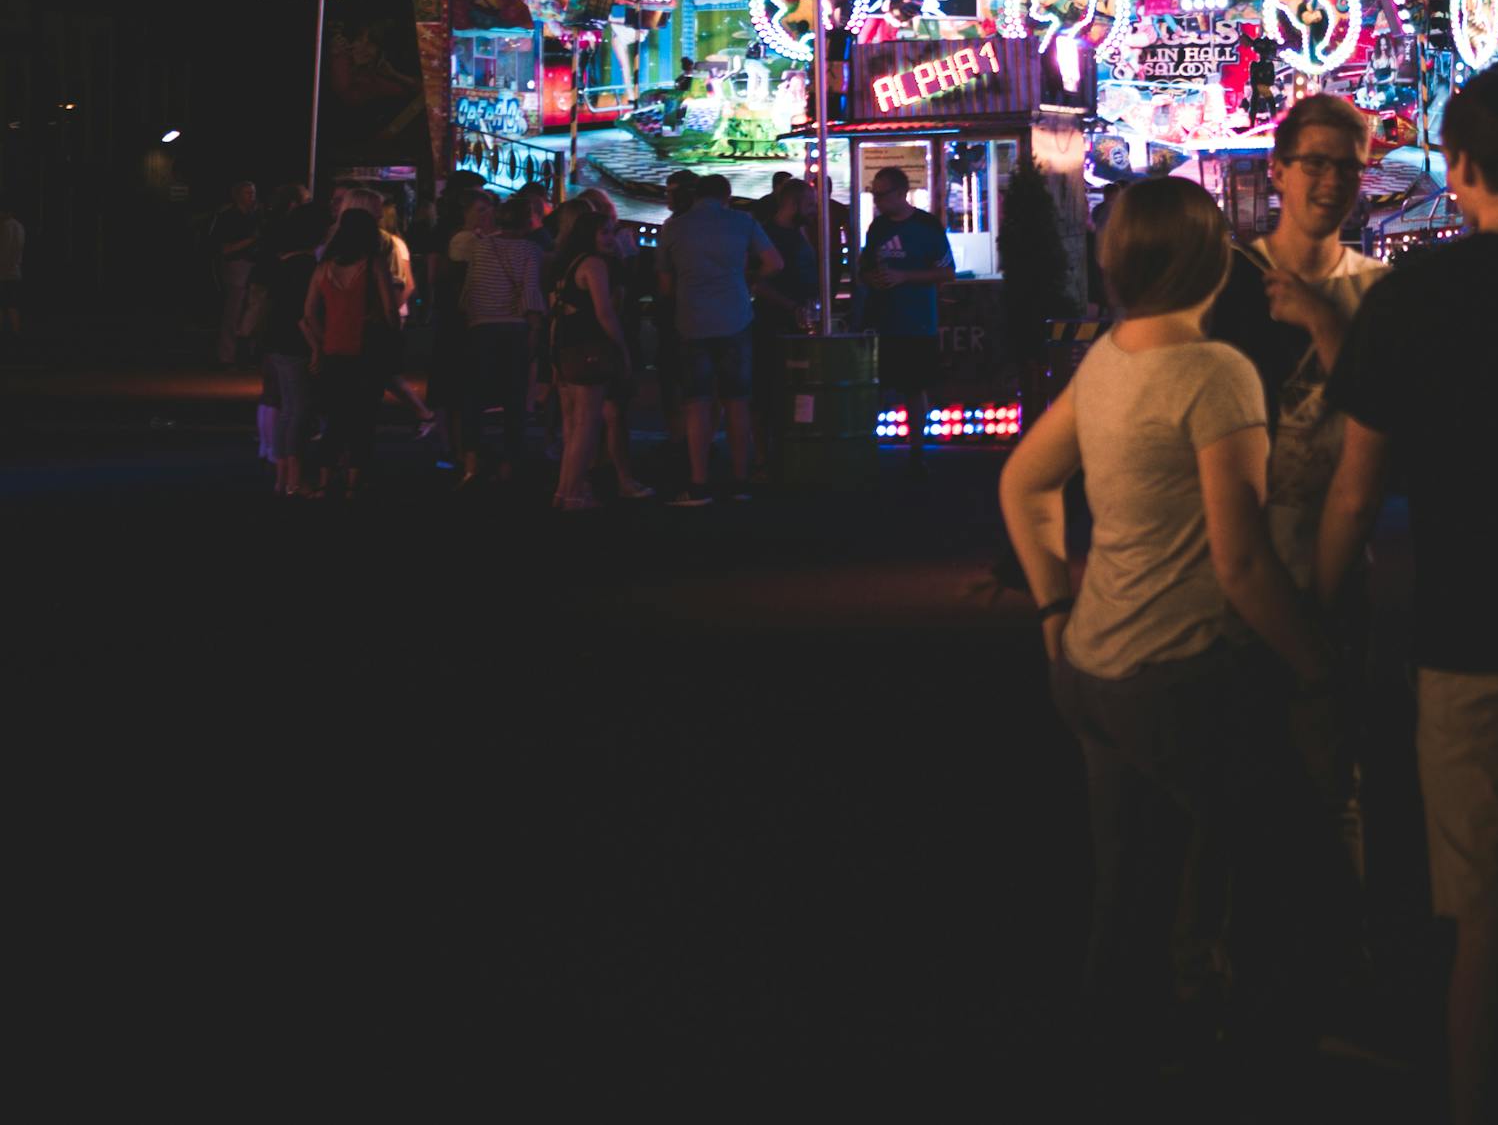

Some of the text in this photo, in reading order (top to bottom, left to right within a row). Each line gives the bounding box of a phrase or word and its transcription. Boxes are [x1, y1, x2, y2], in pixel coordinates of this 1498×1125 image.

[1184, 47, 1236, 62] HALL
[1145, 62, 1218, 77] SALOON
[873, 42, 1001, 113] ALPHA 1
